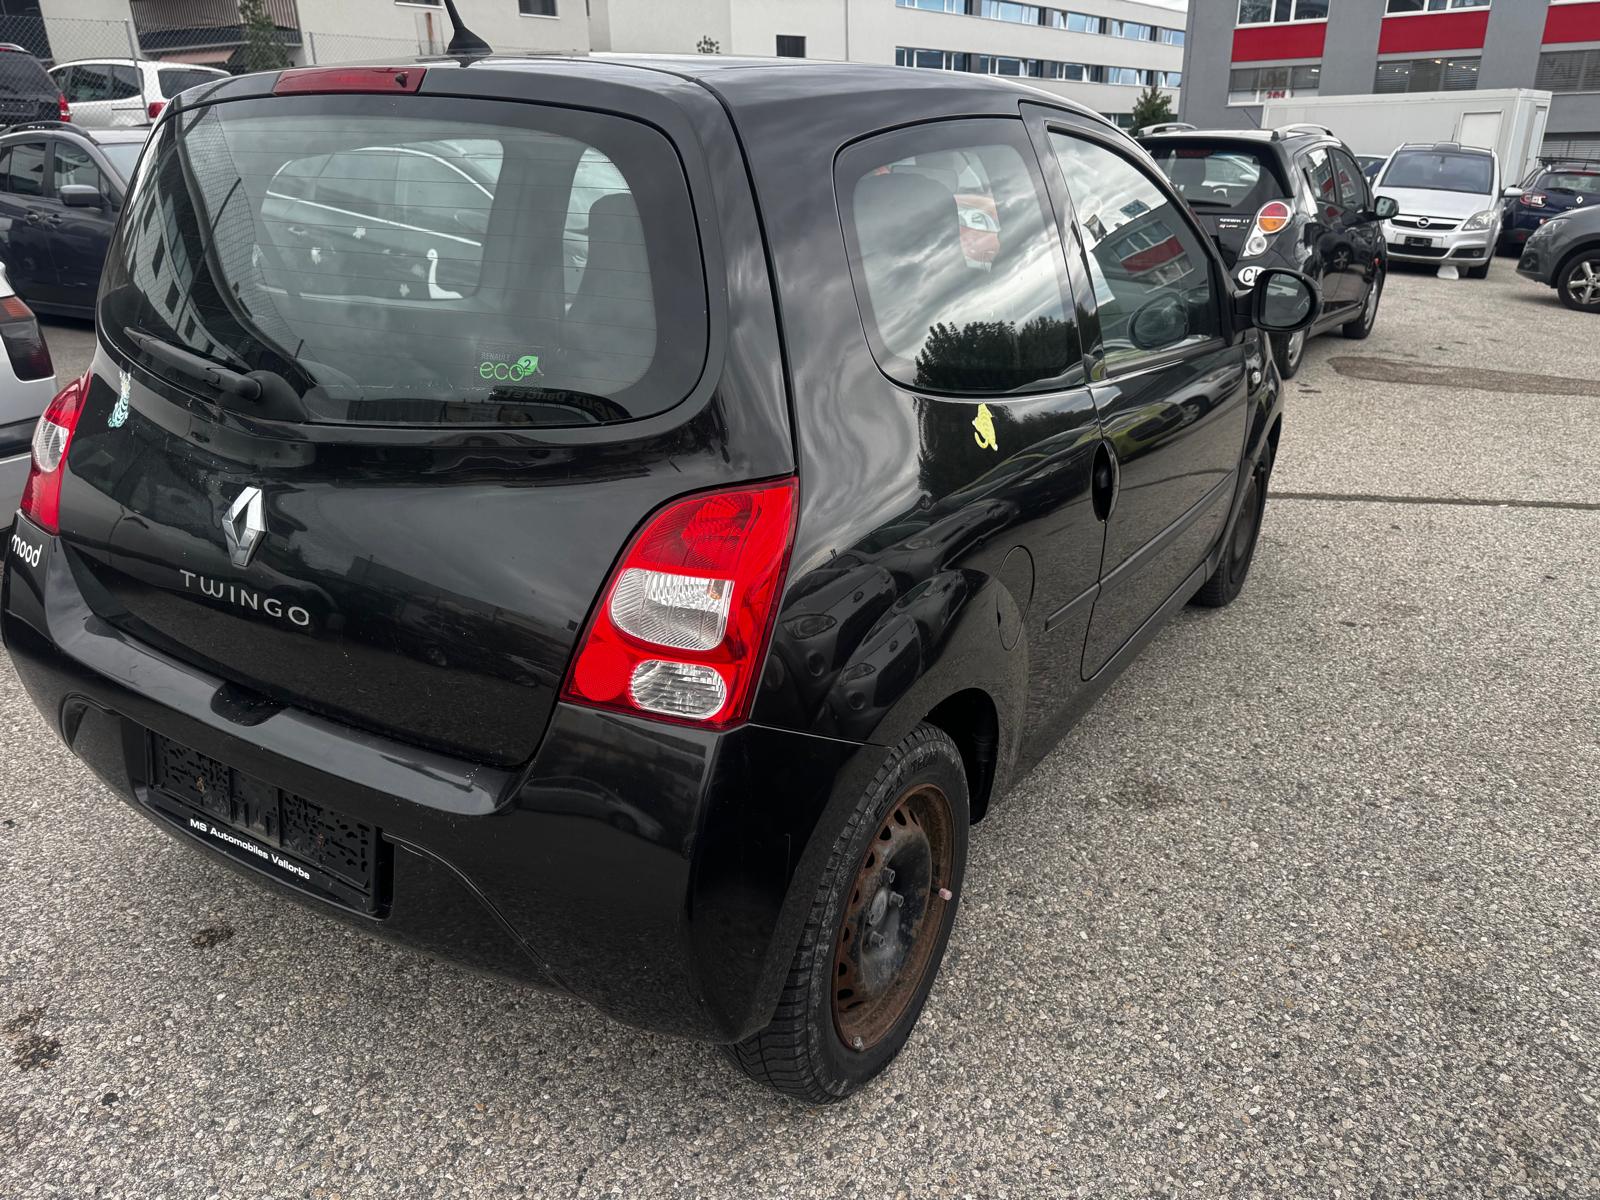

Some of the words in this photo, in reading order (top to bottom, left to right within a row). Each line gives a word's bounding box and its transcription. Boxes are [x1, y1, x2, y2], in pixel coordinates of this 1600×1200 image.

[11, 534, 43, 568] mood
[179, 569, 310, 626] TWINGO
[189, 818, 208, 833] MS
[210, 827, 269, 860] Automobiles
[270, 853, 311, 880] Vallorbe
